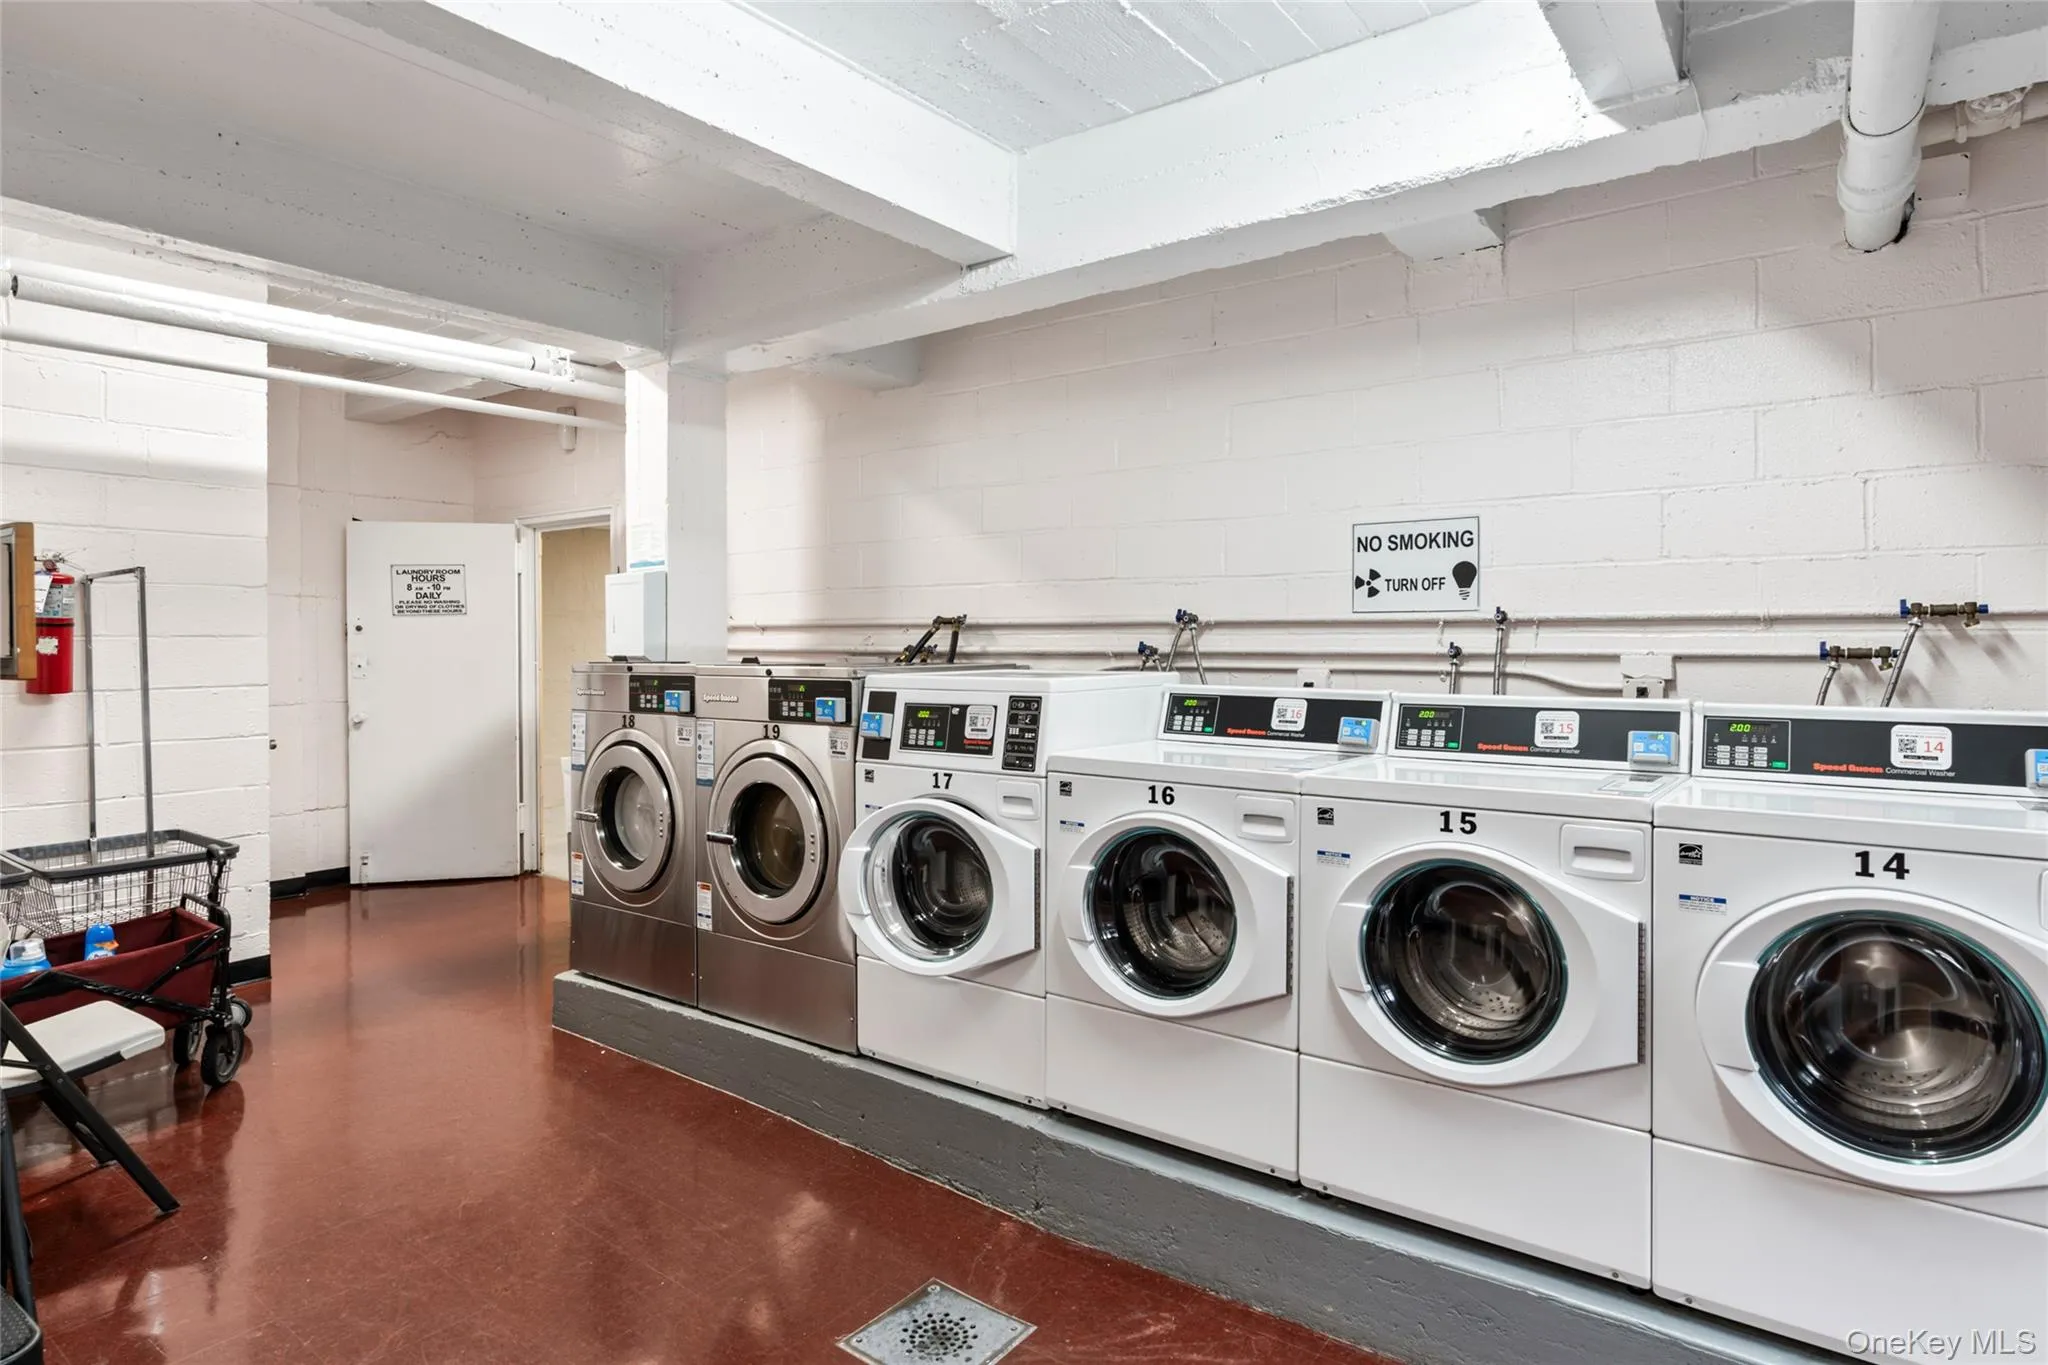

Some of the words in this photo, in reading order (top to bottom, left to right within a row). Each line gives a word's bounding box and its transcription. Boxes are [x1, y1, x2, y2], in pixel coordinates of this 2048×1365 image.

[1357, 535, 1382, 553] NO
[1387, 530, 1474, 551] SMOKING
[406, 583, 413, 591] 8
[432, 583, 441, 591] 10
[1384, 578, 1418, 592] TURN
[1421, 577, 1446, 591] OFF
[415, 592, 442, 600] DAILY
[621, 714, 636, 728] 18
[1290, 709, 1303, 719] 16
[980, 717, 992, 727] 17
[1558, 723, 1574, 734] 15
[763, 724, 781, 739] 19
[839, 740, 849, 750] 19
[1477, 743, 1502, 751] Speed
[1924, 740, 1945, 753] 14
[1812, 762, 1847, 772] Speed
[1848, 763, 1884, 774] Queen
[1885, 767, 1928, 776] Commercial
[1929, 769, 1956, 777] Washer
[932, 772, 953, 789] 17
[1148, 785, 1175, 806] 16
[1439, 810, 1478, 835] 15
[1854, 850, 1910, 880] 14
